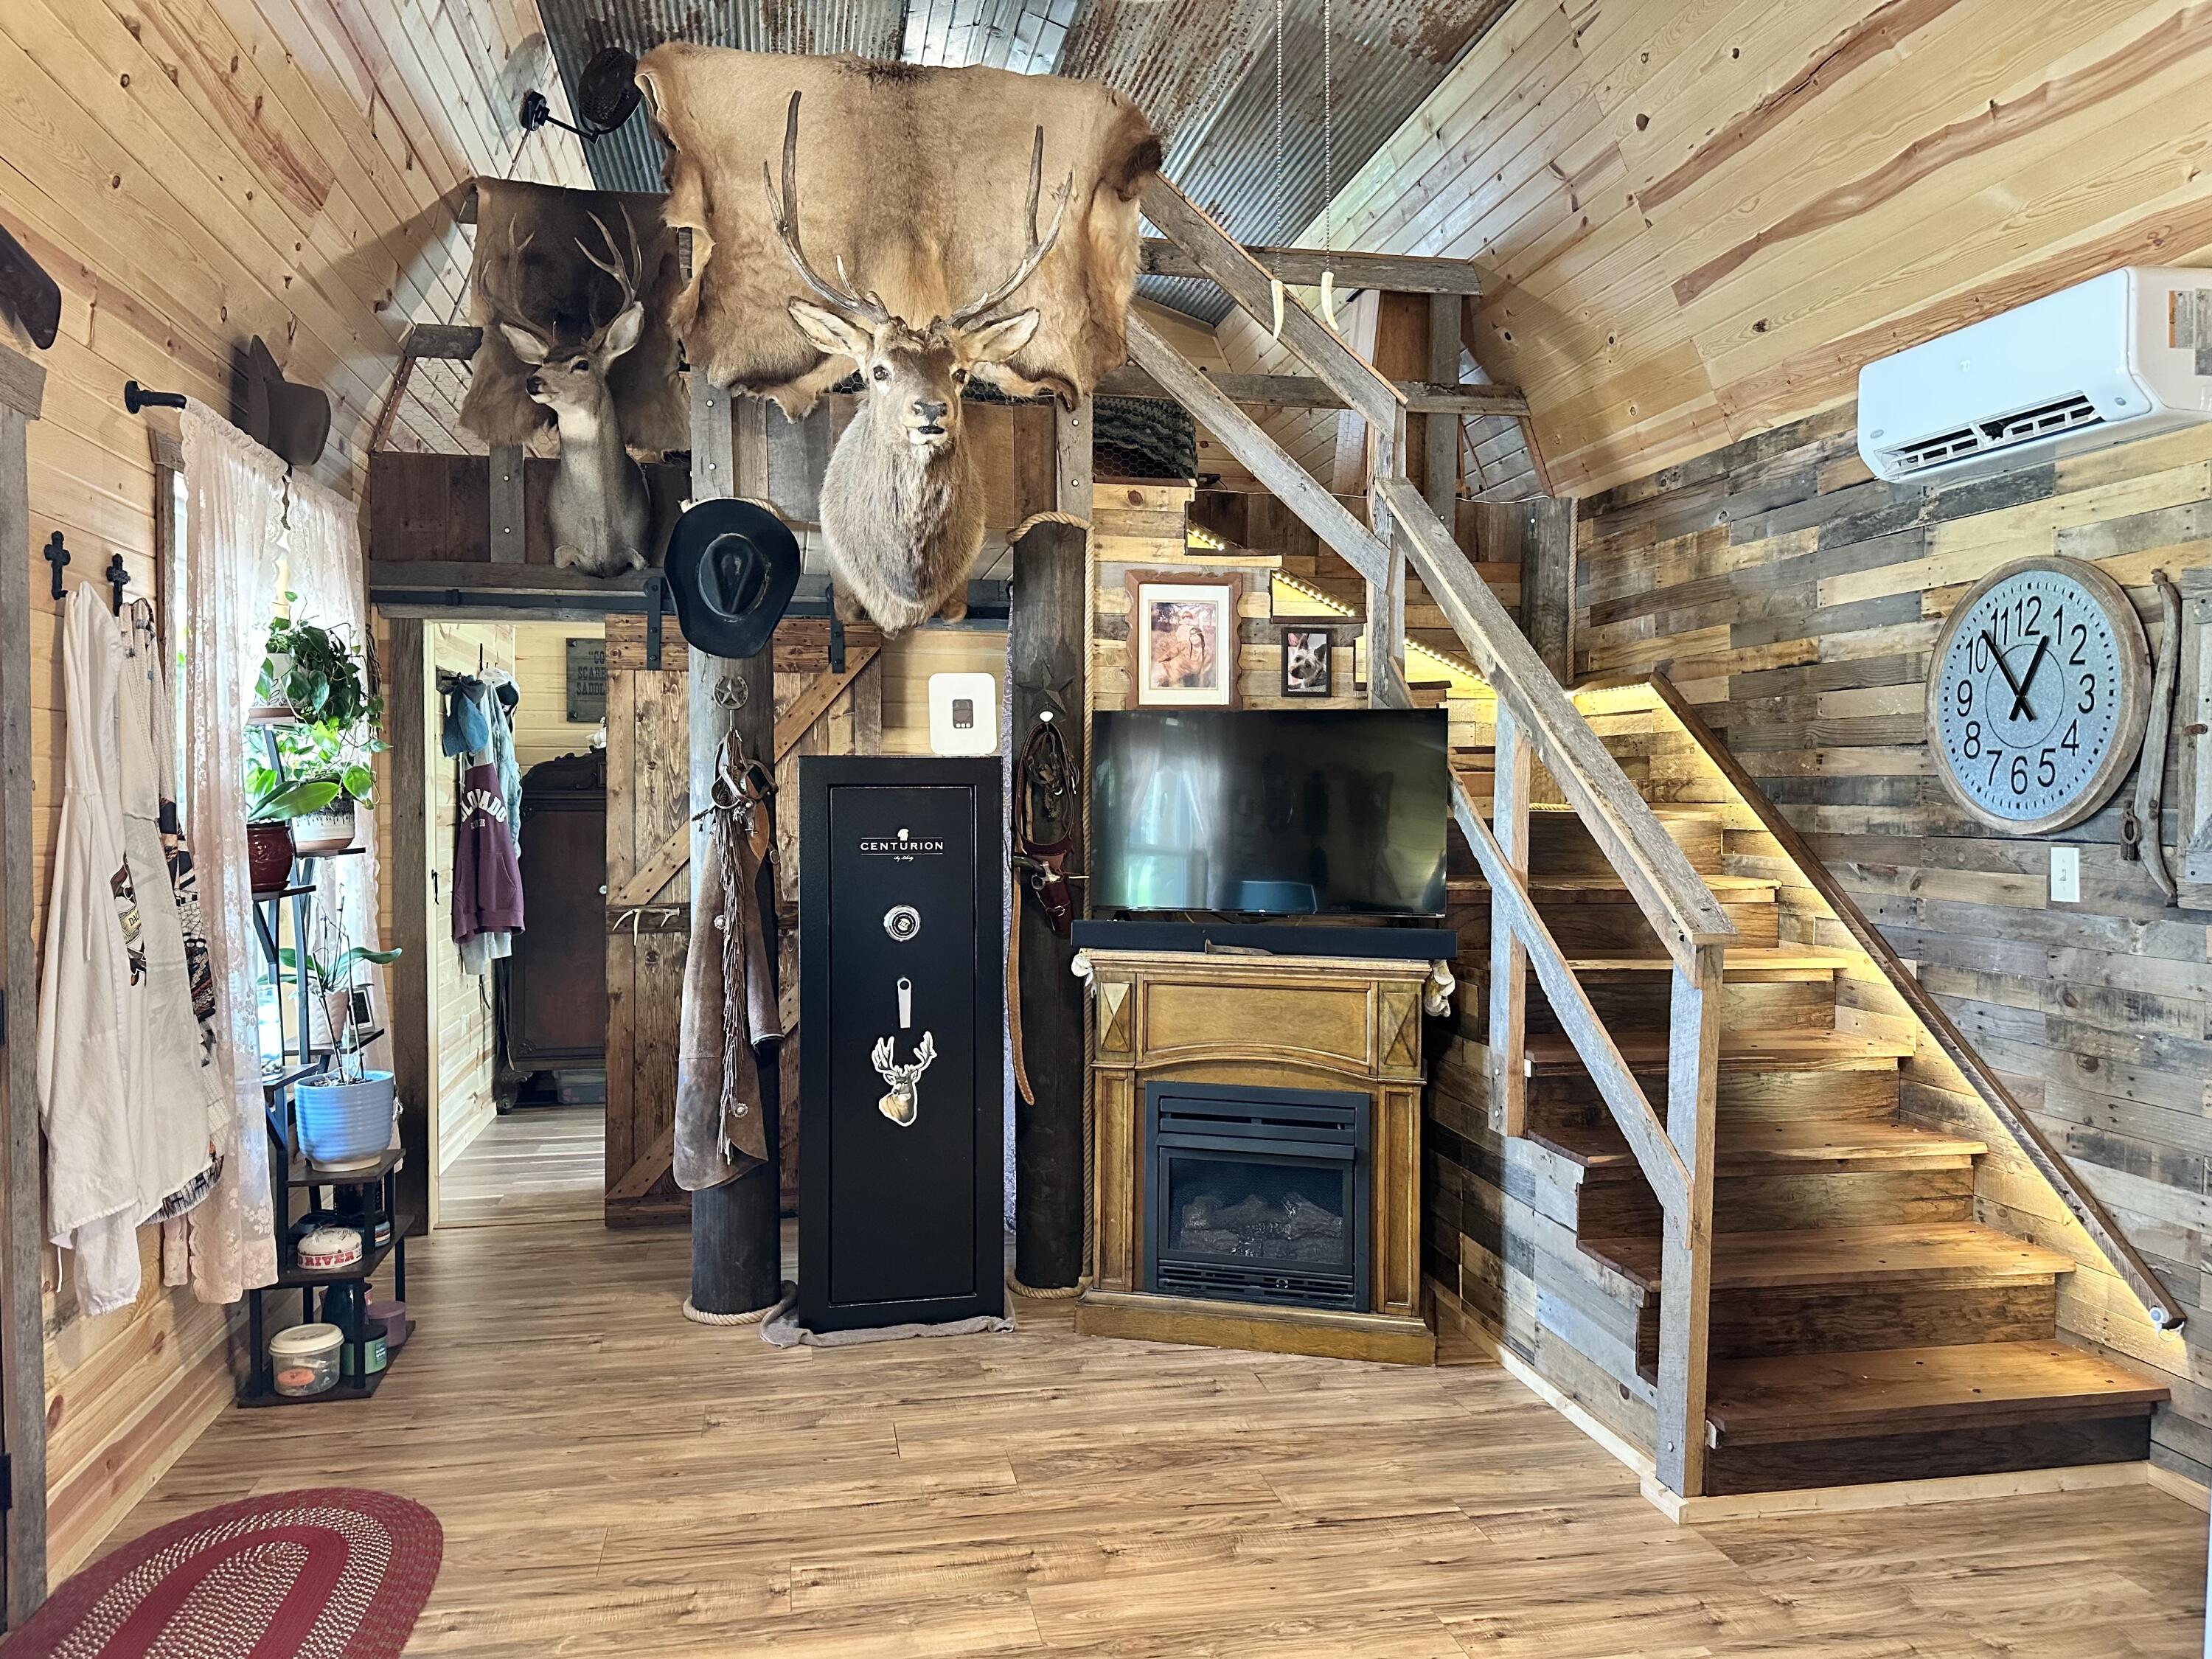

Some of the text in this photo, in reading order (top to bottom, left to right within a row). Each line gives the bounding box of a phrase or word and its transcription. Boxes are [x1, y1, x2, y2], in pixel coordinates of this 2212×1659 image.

[1991, 608, 2008, 646] 11
[2015, 596, 2041, 636] 12
[2053, 605, 2063, 645] 1
[1965, 633, 1989, 675] 10
[2069, 624, 2087, 665] 2
[577, 666, 606, 681] SCARE
[577, 682, 605, 695] SADDL
[1956, 680, 1973, 717] 9
[2078, 674, 2096, 714] 3
[1964, 720, 1981, 759] 8
[2061, 718, 2080, 757] 4
[1986, 750, 2003, 787] 7
[2011, 755, 2028, 795] 6
[2037, 748, 2056, 787] 5
[860, 841, 943, 851] CENTURION
[305, 1251, 355, 1267] RIVER
